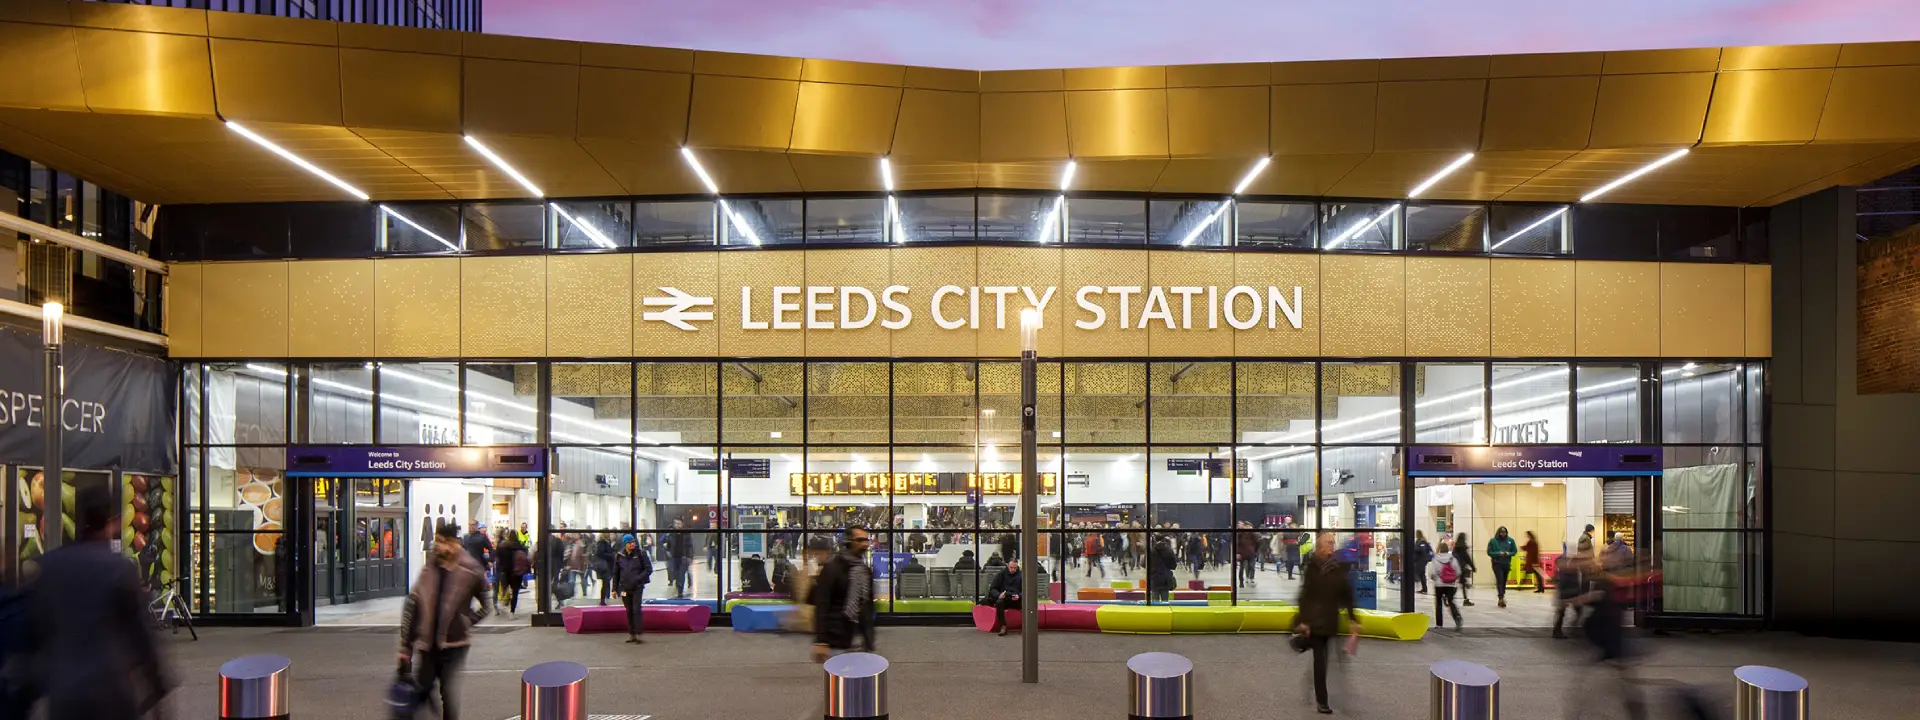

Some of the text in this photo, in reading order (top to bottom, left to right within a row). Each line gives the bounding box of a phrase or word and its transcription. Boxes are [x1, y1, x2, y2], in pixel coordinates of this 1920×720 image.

[742, 285, 1303, 330] LEEDS CITY STATION
[0, 389, 106, 434] SPECER
[1498, 419, 1549, 444] TICKETS
[368, 460, 446, 471] Leeds City Station
[1492, 459, 1569, 470] Leeds City Station
